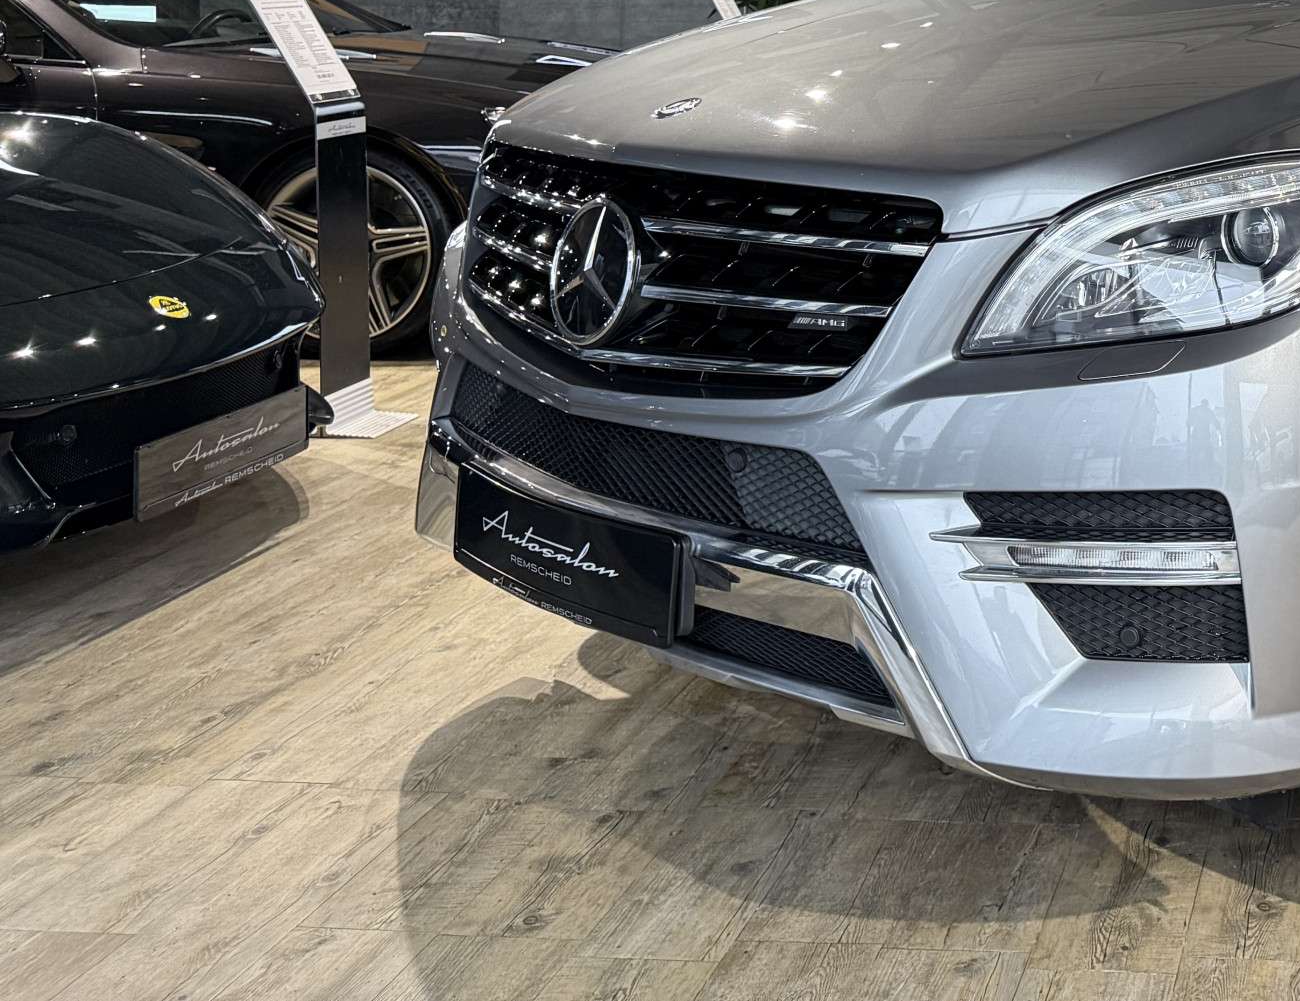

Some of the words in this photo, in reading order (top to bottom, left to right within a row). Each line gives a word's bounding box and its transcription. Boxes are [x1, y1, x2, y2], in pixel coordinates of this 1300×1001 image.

[172, 416, 280, 472] Autosalon
[224, 453, 284, 485] REMSCHEID
[482, 510, 620, 578] Autosalon
[510, 554, 572, 586] REMSCHEID
[540, 601, 593, 625] REMSCHEID
